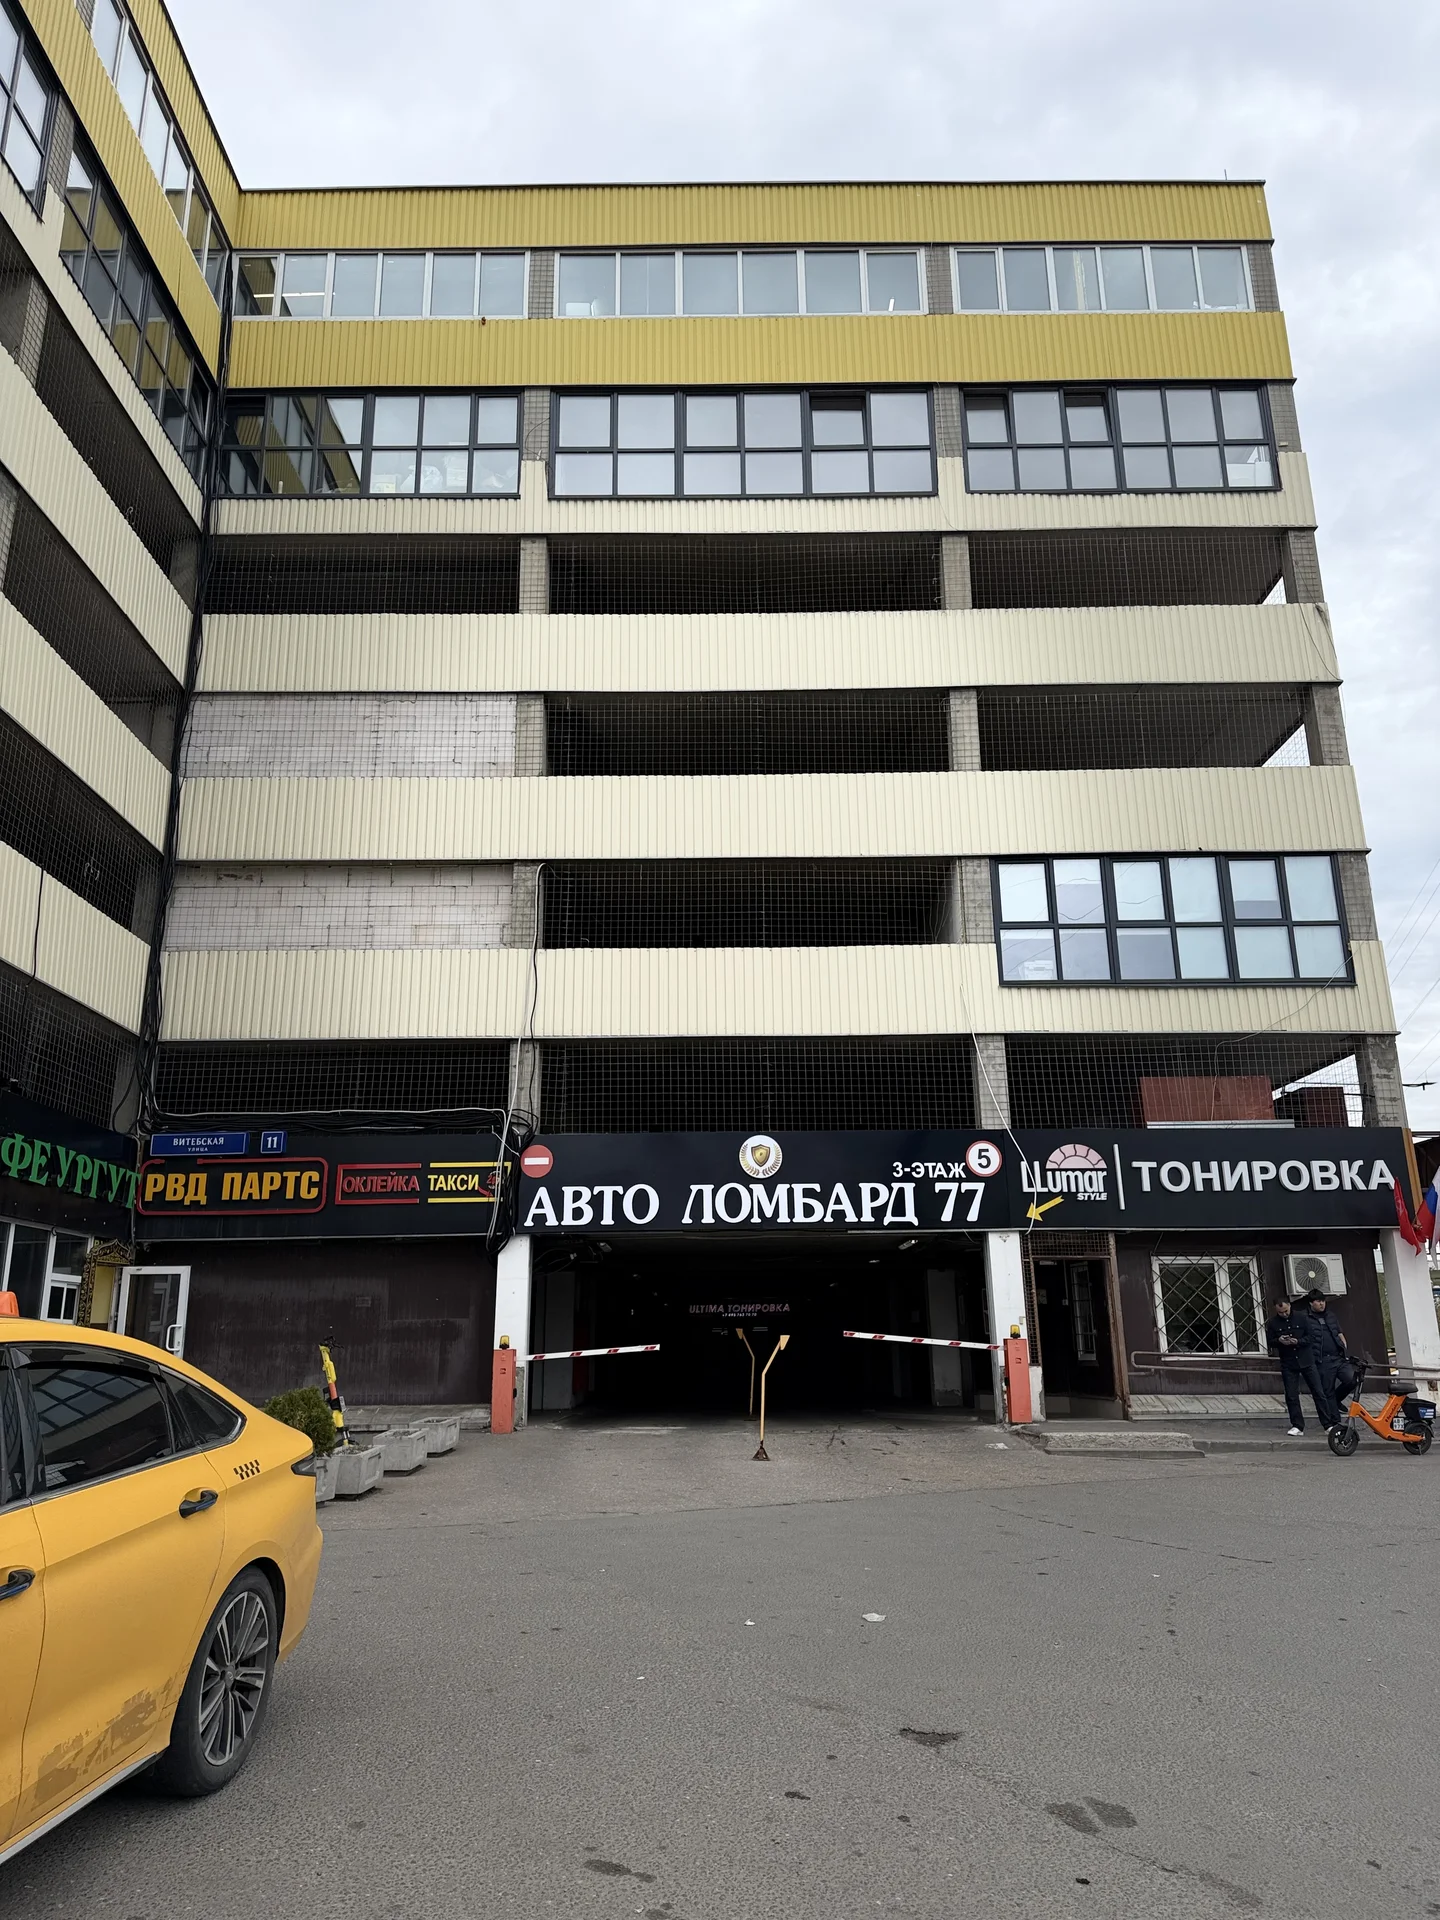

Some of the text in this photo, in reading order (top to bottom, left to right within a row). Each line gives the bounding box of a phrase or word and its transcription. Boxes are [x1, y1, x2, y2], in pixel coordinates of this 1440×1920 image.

[172, 1136, 225, 1147] ВИТЕБСКАЯ
[266, 1136, 278, 1149] 11
[976, 1148, 991, 1169] 5
[57, 1145, 143, 1209] УРГУТ
[892, 1161, 967, 1179] 3-ЭТАЖ
[1020, 1161, 1107, 1193] LLumar
[1131, 1159, 1397, 1193] ТОНИРОВКА
[144, 1171, 320, 1206] РВД ПАРТС
[342, 1171, 480, 1194] ОКЛЕЙКА ТАКСИ
[524, 1182, 986, 1227] АВТО ЛОМБАРД 77
[1077, 1193, 1108, 1201] STYLE
[689, 1303, 791, 1314] ULTIMA ТОНИРОВКА
